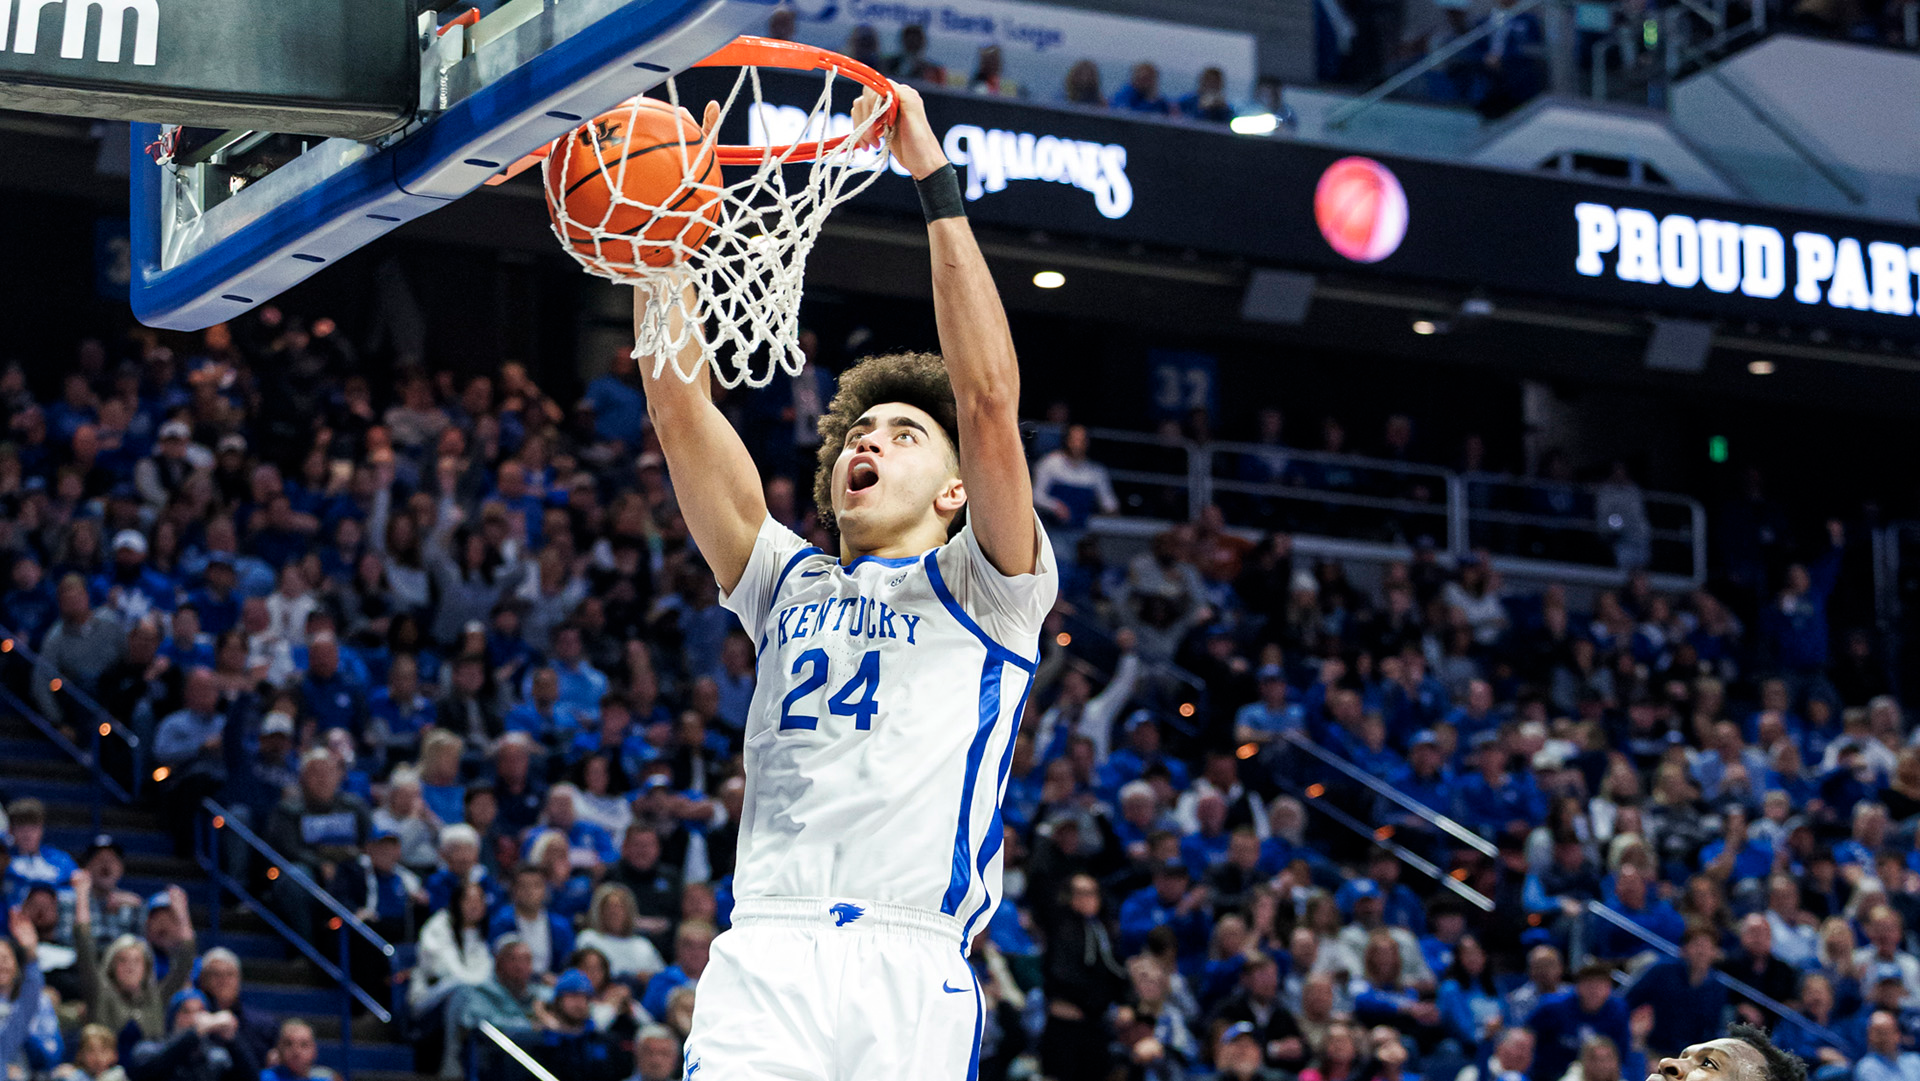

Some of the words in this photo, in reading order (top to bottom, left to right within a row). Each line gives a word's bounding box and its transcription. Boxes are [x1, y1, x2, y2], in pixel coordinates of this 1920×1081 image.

[0, 0, 159, 66] rm
[940, 8, 994, 34] Bank
[1575, 202, 1785, 299] PROUD
[778, 596, 920, 650] KENTUCKY
[779, 648, 880, 731] 24
